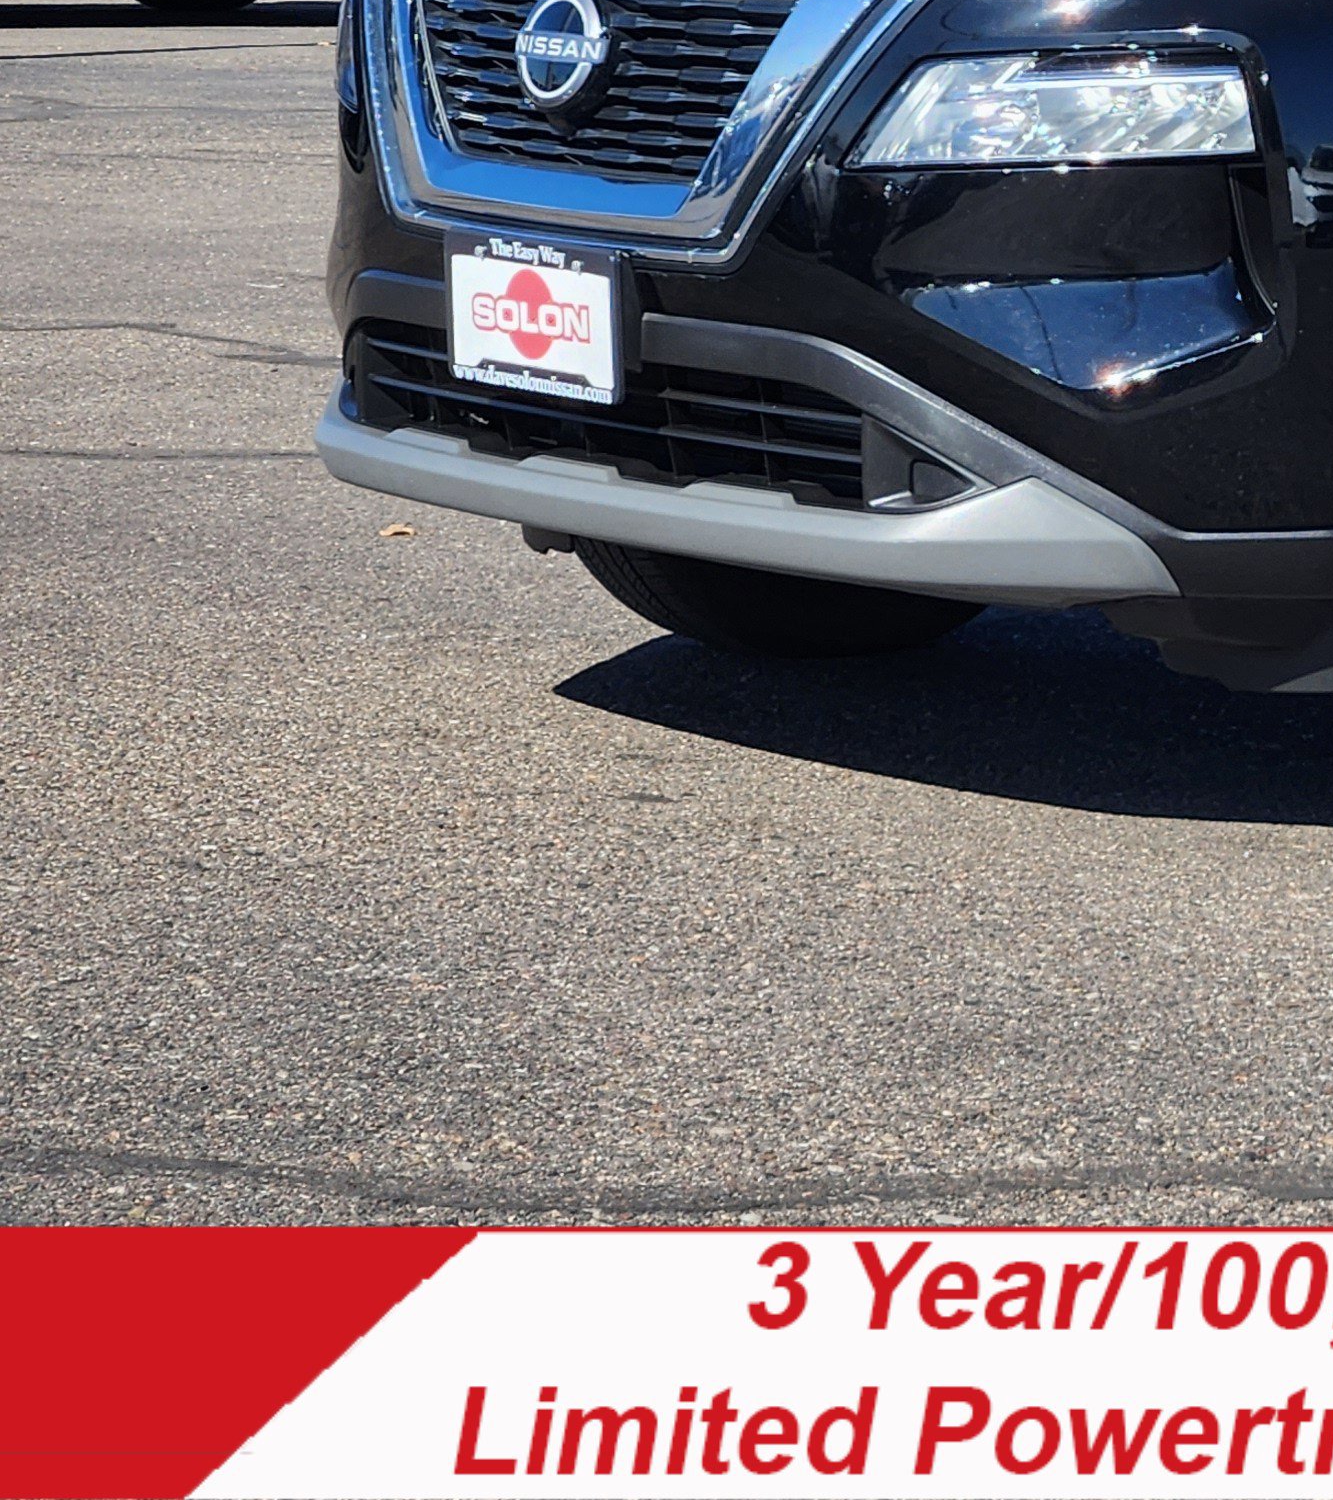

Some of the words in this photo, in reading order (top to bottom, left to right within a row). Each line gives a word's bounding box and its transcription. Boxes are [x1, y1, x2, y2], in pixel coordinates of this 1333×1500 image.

[515, 32, 602, 61] NISSAN
[488, 237, 514, 259] The
[512, 241, 540, 267] Easy
[538, 244, 567, 270] Way
[472, 292, 591, 344] SOLON
